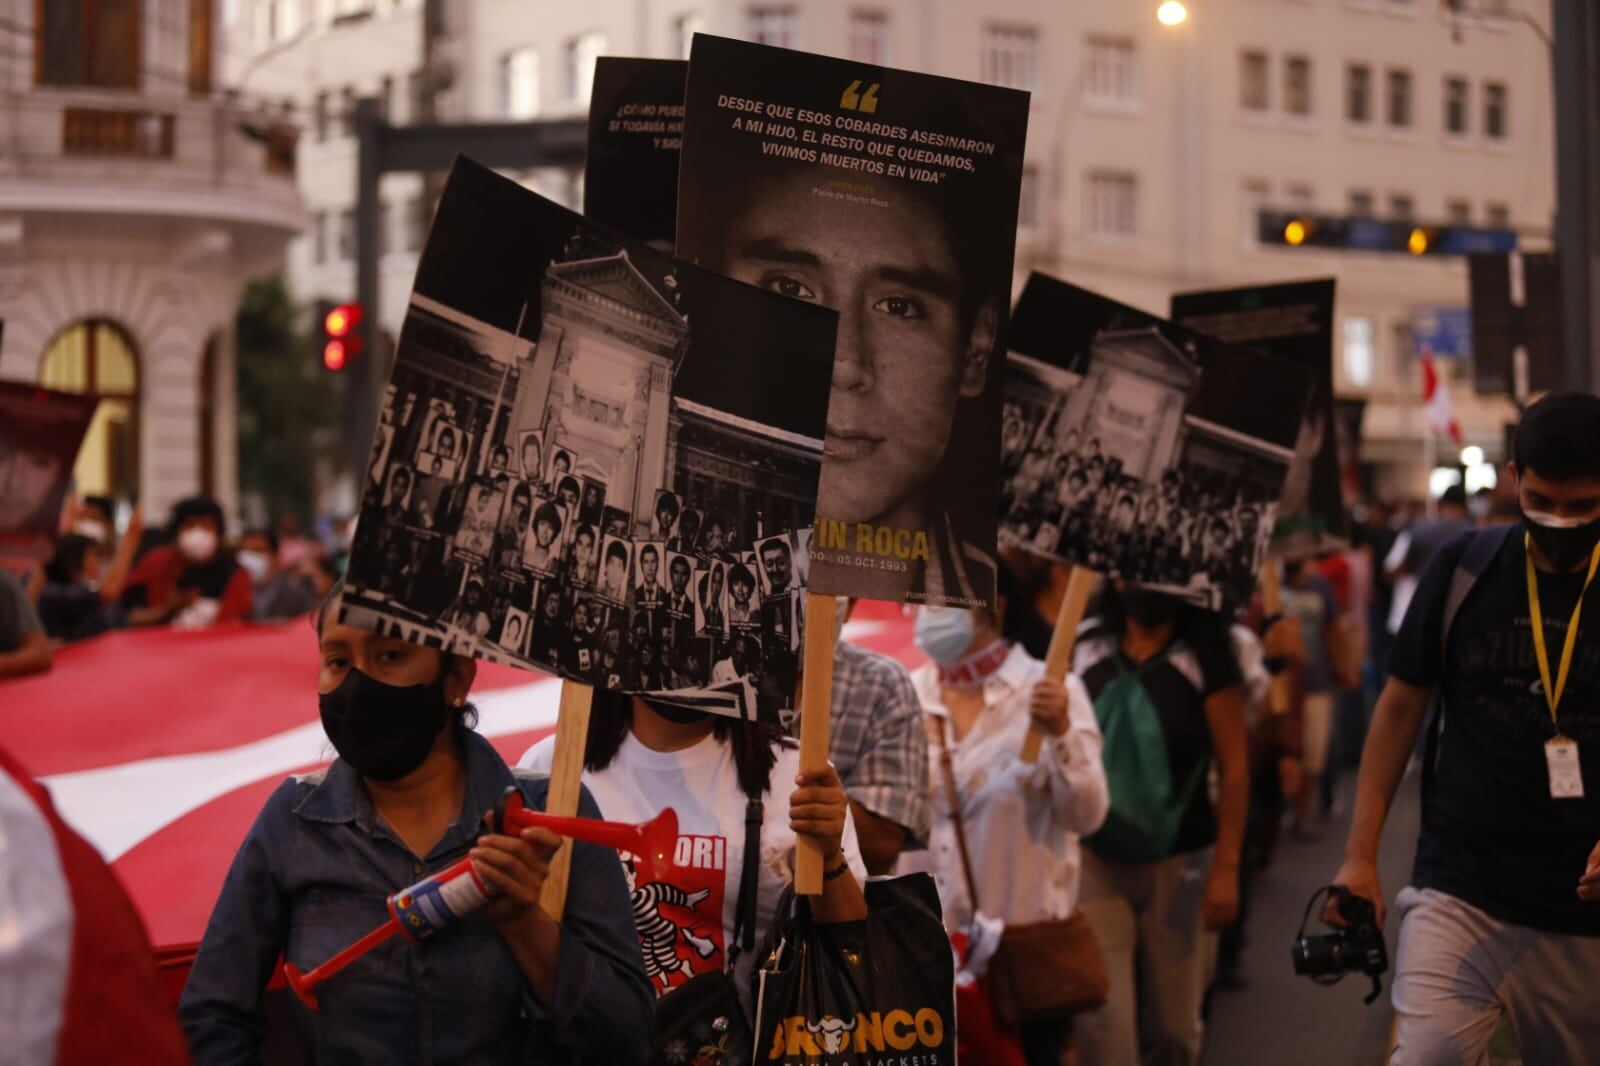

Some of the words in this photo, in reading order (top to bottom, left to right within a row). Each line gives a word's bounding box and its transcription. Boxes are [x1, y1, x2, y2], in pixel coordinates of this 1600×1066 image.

[717, 94, 764, 114] DESDE
[766, 103, 795, 120] QUE
[797, 108, 832, 127] ESOS
[835, 115, 908, 140] COBARDES
[910, 130, 995, 155] ASESINARON
[732, 117, 742, 131] A
[745, 119, 763, 134] MI
[766, 122, 798, 141] HIJO,
[802, 129, 818, 143] EL
[821, 133, 865, 151] RESTO
[867, 141, 895, 157] QUE
[897, 146, 975, 173] QUEDAMOS,
[762, 141, 817, 162] VIVIMOS
[820, 152, 885, 174] MUERTOS
[887, 163, 906, 179] EN
[855, 523, 930, 562] ROCA
[837, 553, 851, 565] 05
[855, 555, 875, 568] OCT
[879, 560, 908, 573] 1993
